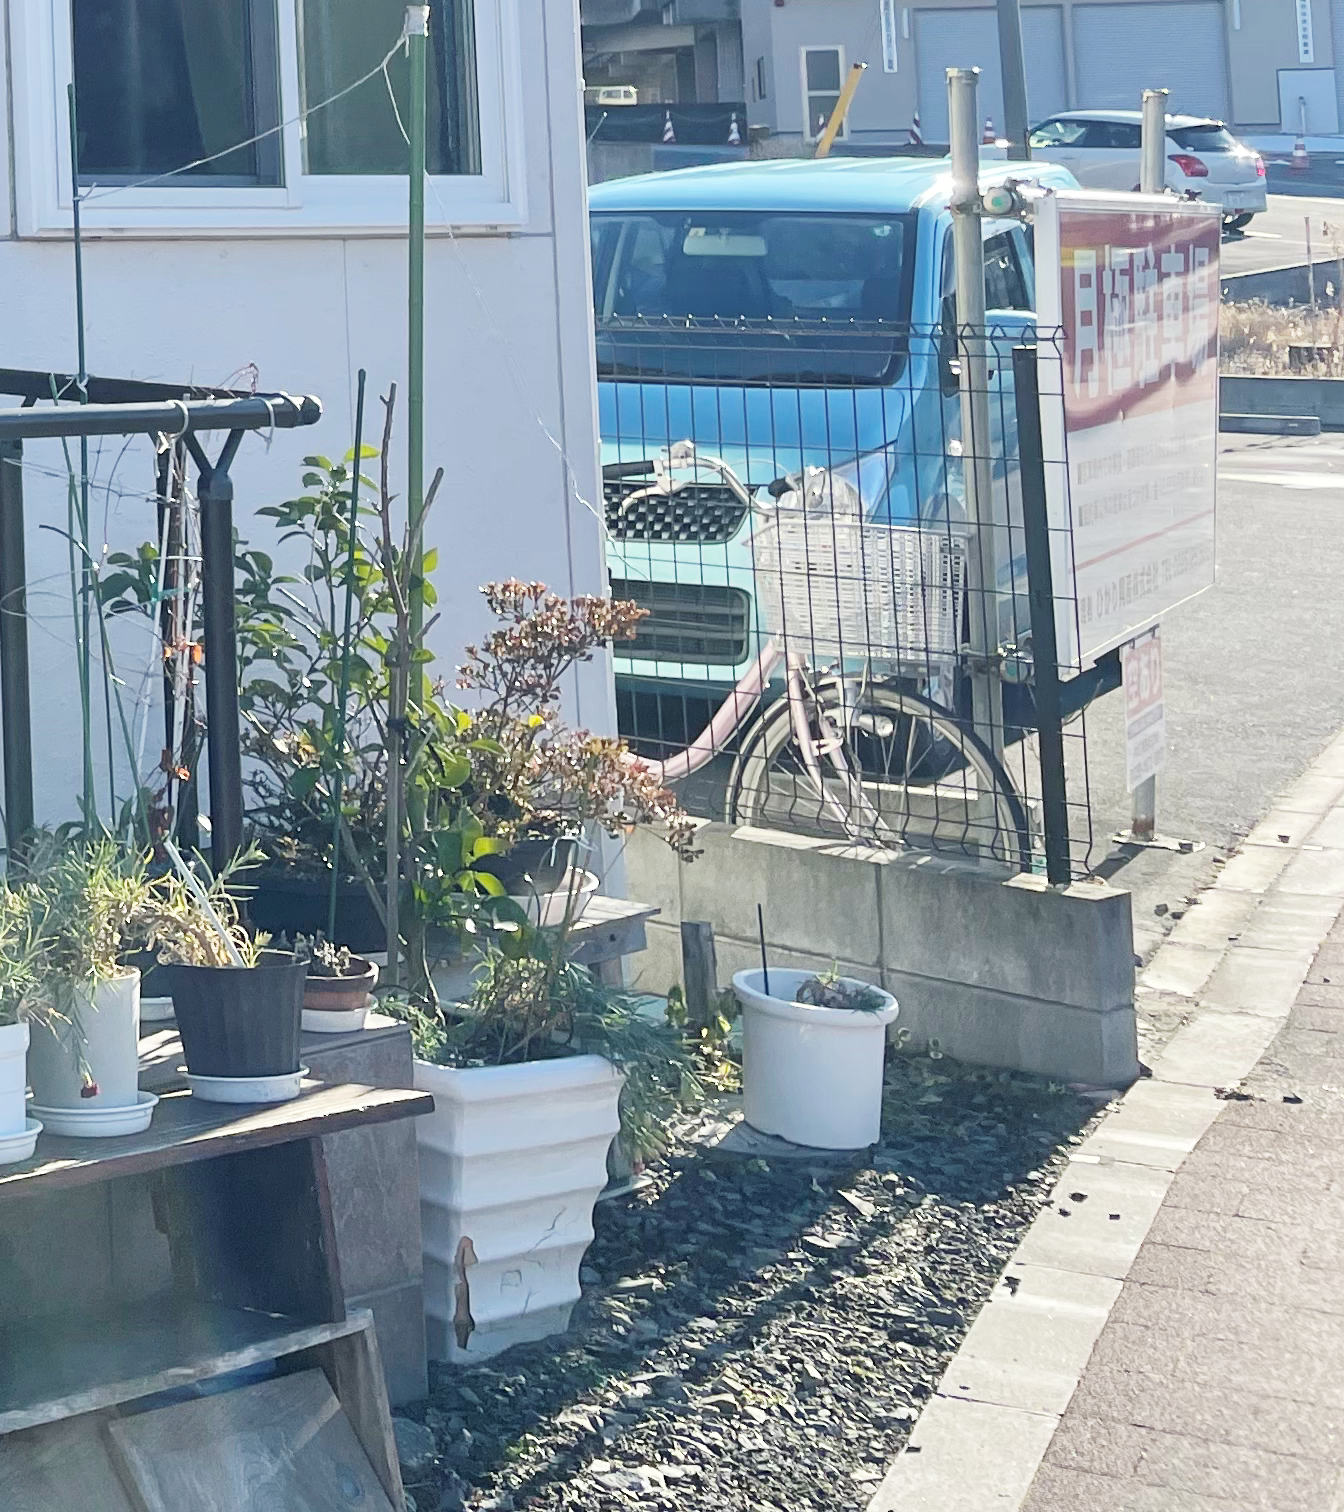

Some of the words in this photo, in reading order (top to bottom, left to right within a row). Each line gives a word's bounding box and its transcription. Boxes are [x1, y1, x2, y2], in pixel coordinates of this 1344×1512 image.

[1074, 242, 1210, 400] 月極駐車場
